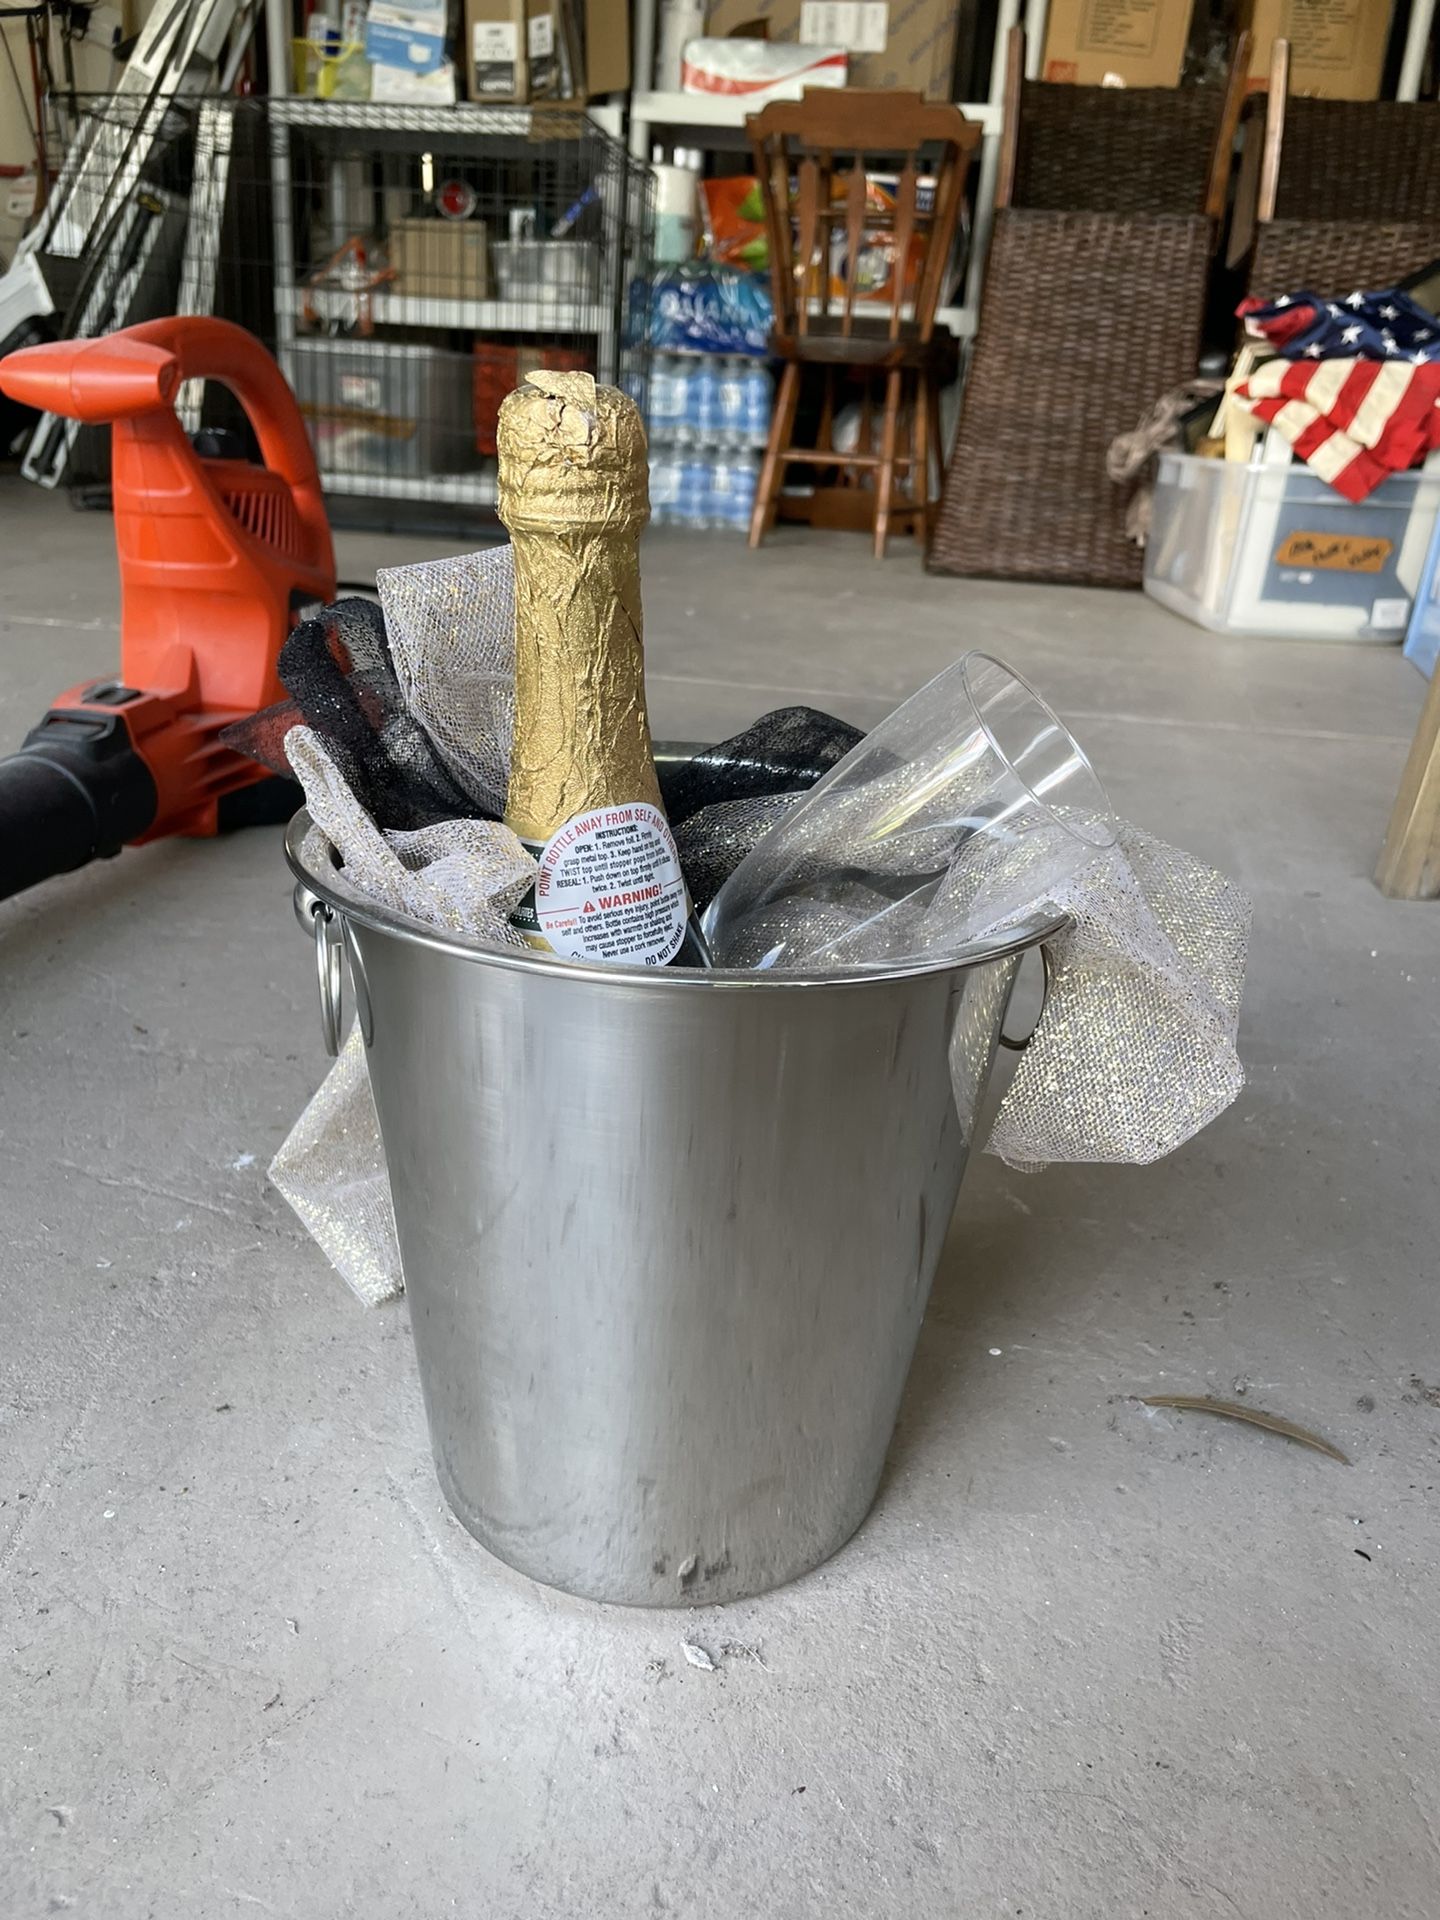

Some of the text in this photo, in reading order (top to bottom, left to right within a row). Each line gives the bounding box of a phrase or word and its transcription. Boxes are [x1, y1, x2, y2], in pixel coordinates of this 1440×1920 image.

[539, 864, 553, 896] POINT
[546, 830, 576, 865] BOTTLE
[575, 816, 602, 836] AWAY
[606, 810, 633, 826] FROM
[635, 809, 652, 823] SELF
[651, 814, 664, 832] AND
[564, 858, 580, 868] grasp
[581, 854, 597, 863] metal
[598, 853, 609, 861] top.
[618, 848, 631, 856] Keep
[632, 844, 643, 853] hand
[575, 844, 594, 854] OPEN:
[602, 839, 625, 849] Remove
[560, 867, 580, 877] TWIST
[594, 863, 608, 872] until
[610, 858, 632, 869] stopper
[633, 855, 646, 864] pops
[556, 878, 582, 888] RESEAL:
[590, 874, 604, 883] Push
[606, 871, 621, 880] down
[630, 867, 639, 875] top
[592, 884, 608, 893] twice.
[617, 879, 632, 888] Twist
[598, 883, 662, 909] WARNING!
[562, 928, 572, 936] self
[573, 926, 584, 935] and
[585, 923, 604, 932] others.
[605, 919, 621, 928] Bottle
[622, 914, 644, 925] contains
[587, 913, 602, 922] avoid
[603, 910, 623, 919] serious
[624, 908, 634, 916] eye
[610, 928, 622, 937] with
[623, 923, 643, 934] warmth
[585, 943, 597, 952] may
[599, 941, 615, 949] cause
[616, 935, 636, 946] stopper
[602, 950, 619, 958] Never
[645, 922, 683, 965] DO NOT SHAKE
